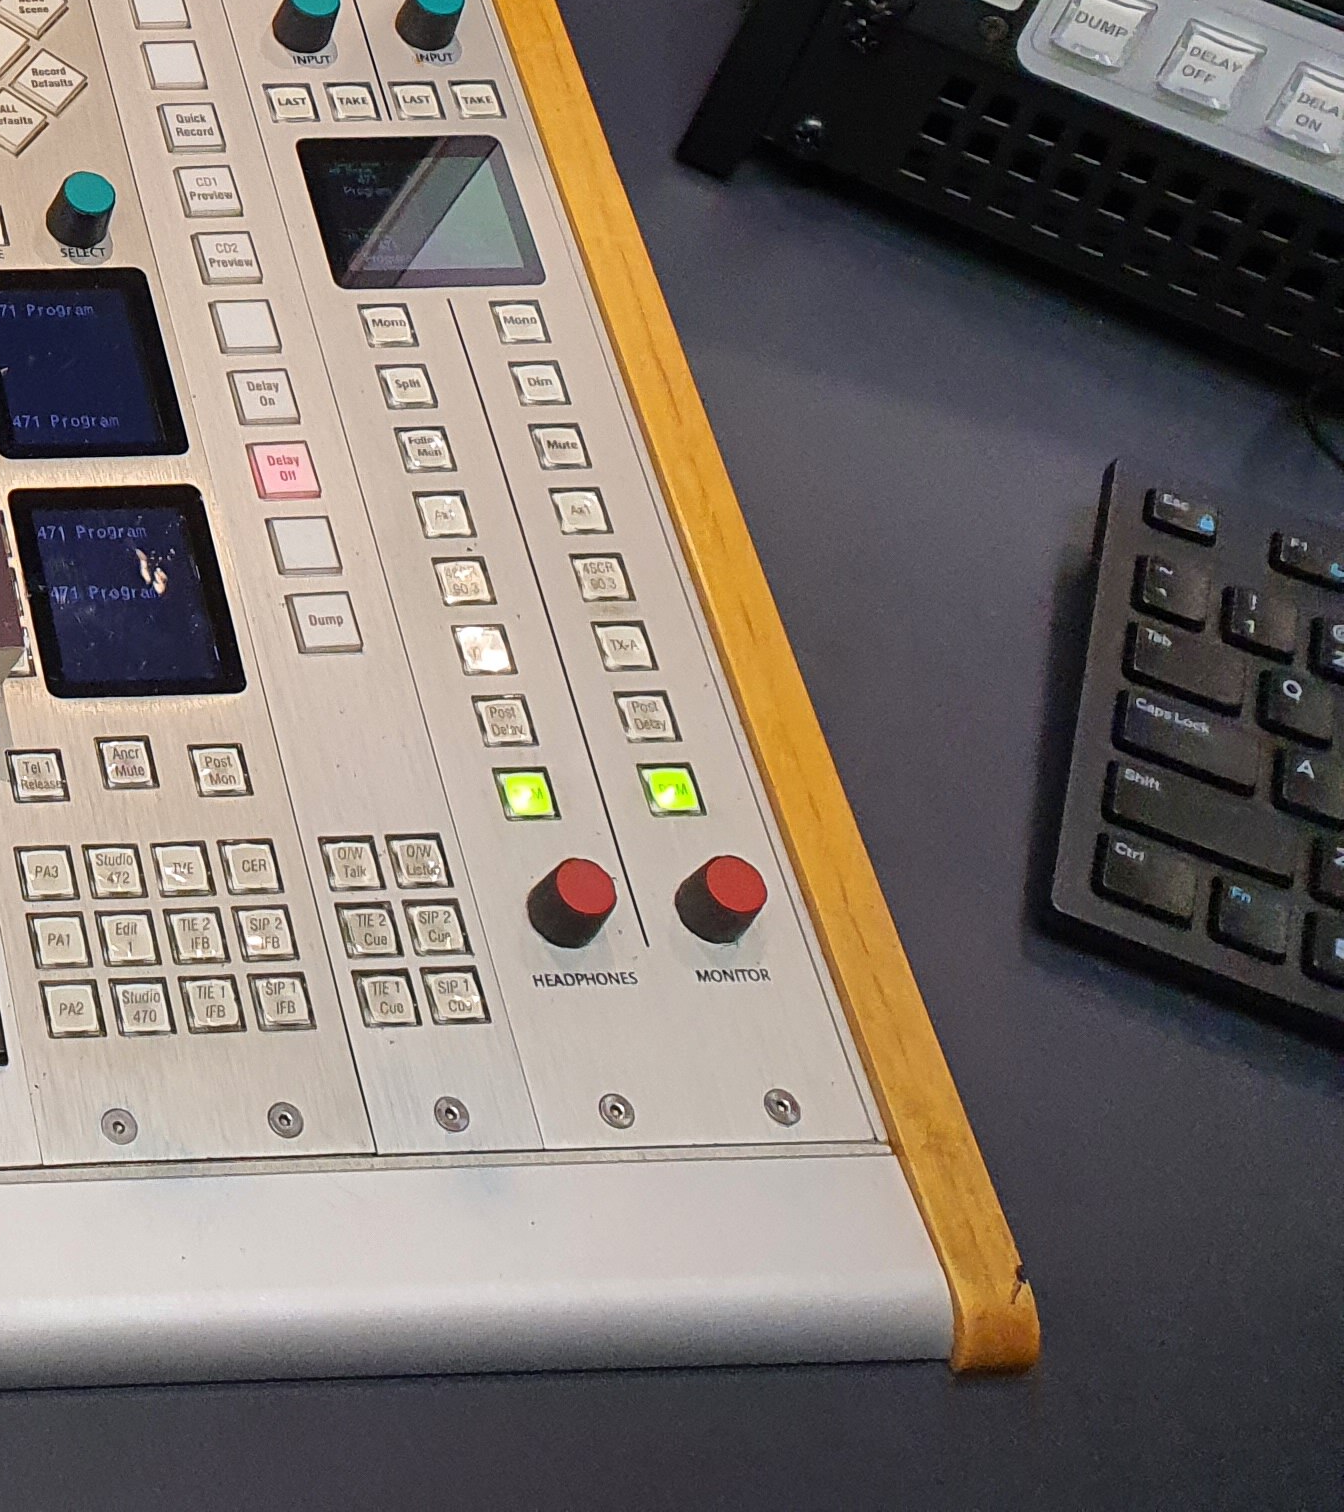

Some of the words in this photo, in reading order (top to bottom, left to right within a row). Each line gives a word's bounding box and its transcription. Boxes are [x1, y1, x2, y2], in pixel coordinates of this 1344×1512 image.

[1075, 9, 1129, 39] DUMP
[1188, 45, 1242, 74] DELAY
[1181, 64, 1217, 84] OFF
[176, 113, 206, 126] Quick
[1295, 113, 1322, 133] ON
[176, 124, 214, 138] Record
[60, 245, 106, 259] SELECT
[26, 302, 95, 320] Program
[247, 379, 280, 396] Delay
[259, 394, 276, 408] On
[308, 612, 344, 629] Dump
[1135, 697, 1174, 726] Caps
[1174, 711, 1210, 734] Lock
[1124, 767, 1161, 792] Shift
[95, 852, 134, 868] Studio
[1115, 841, 1145, 863] Ctrl
[34, 864, 60, 880] PA3
[241, 857, 267, 874] CER
[533, 971, 638, 987] HEADPHONES
[695, 967, 772, 985] MONITOR
